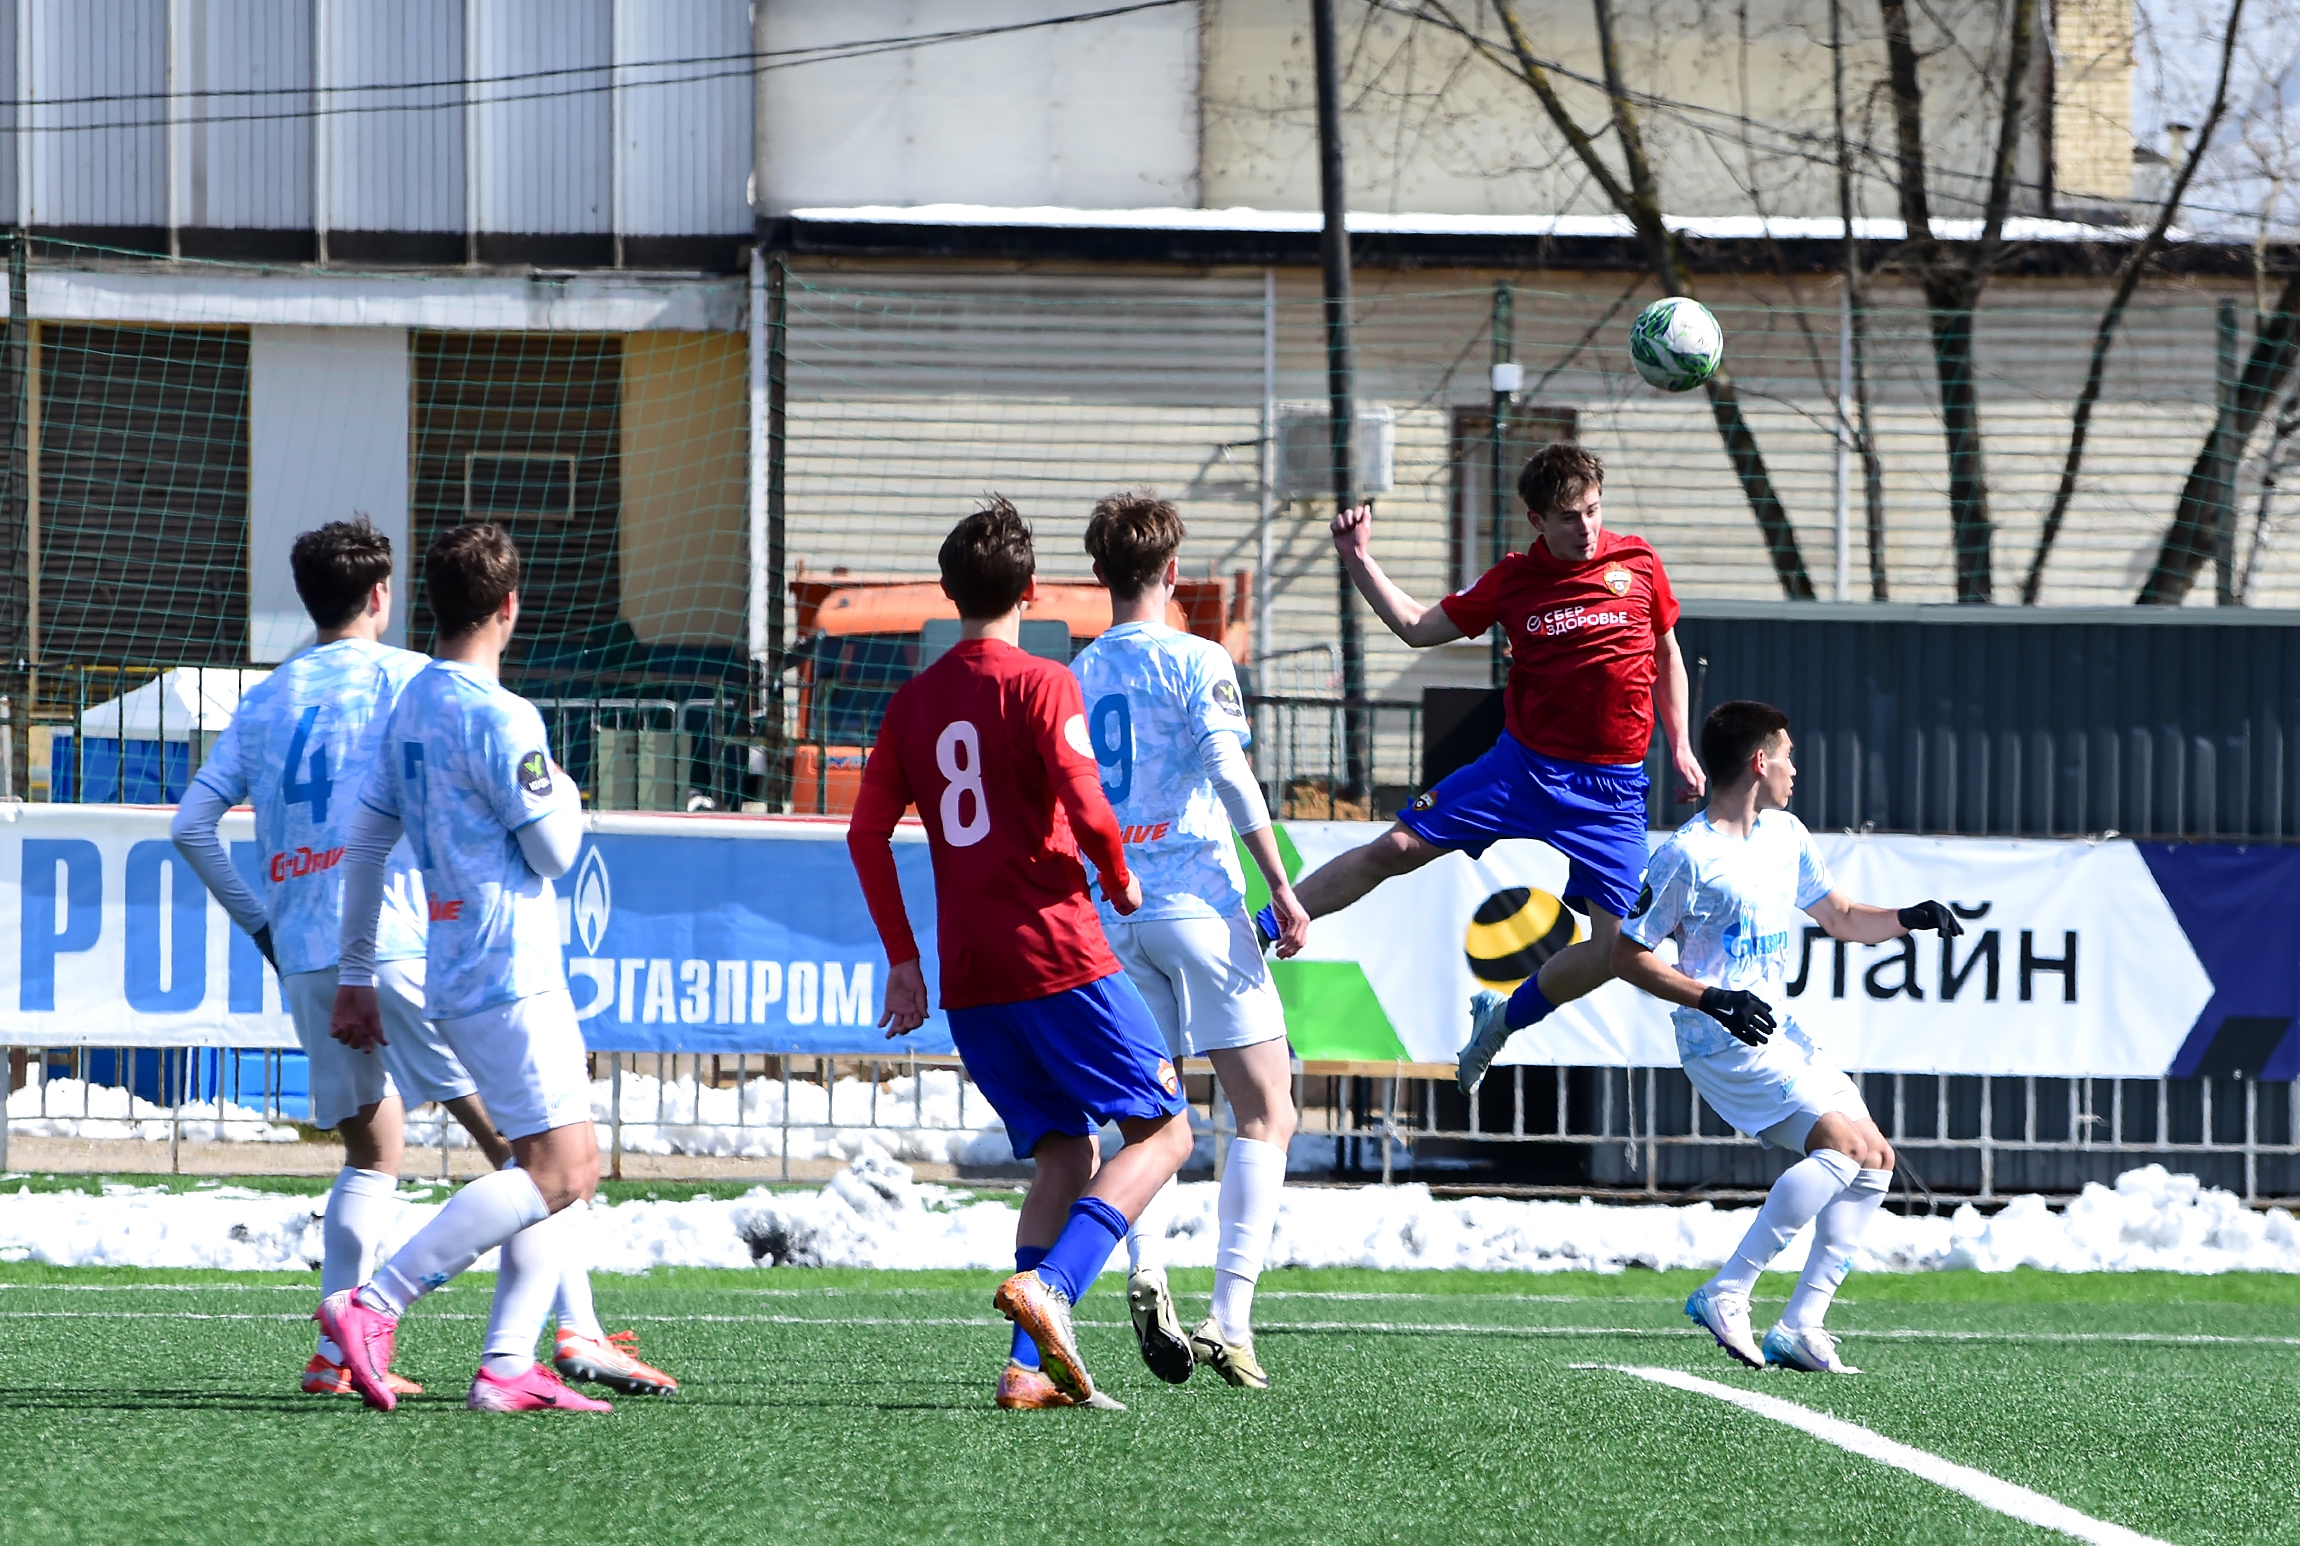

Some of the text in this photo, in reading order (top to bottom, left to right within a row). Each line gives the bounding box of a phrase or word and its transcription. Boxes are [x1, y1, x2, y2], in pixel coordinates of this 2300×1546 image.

[1544, 606, 1585, 623] СБЕР
[1546, 611, 1628, 636] ЗДОРОВЬЕ
[283, 705, 333, 824] 4
[936, 720, 990, 847] 8
[1090, 693, 1132, 805] 9
[270, 846, 346, 883] G-DRIV
[618, 958, 874, 1026] ГАЗПРОМ
[1786, 900, 2078, 1003] лайн
